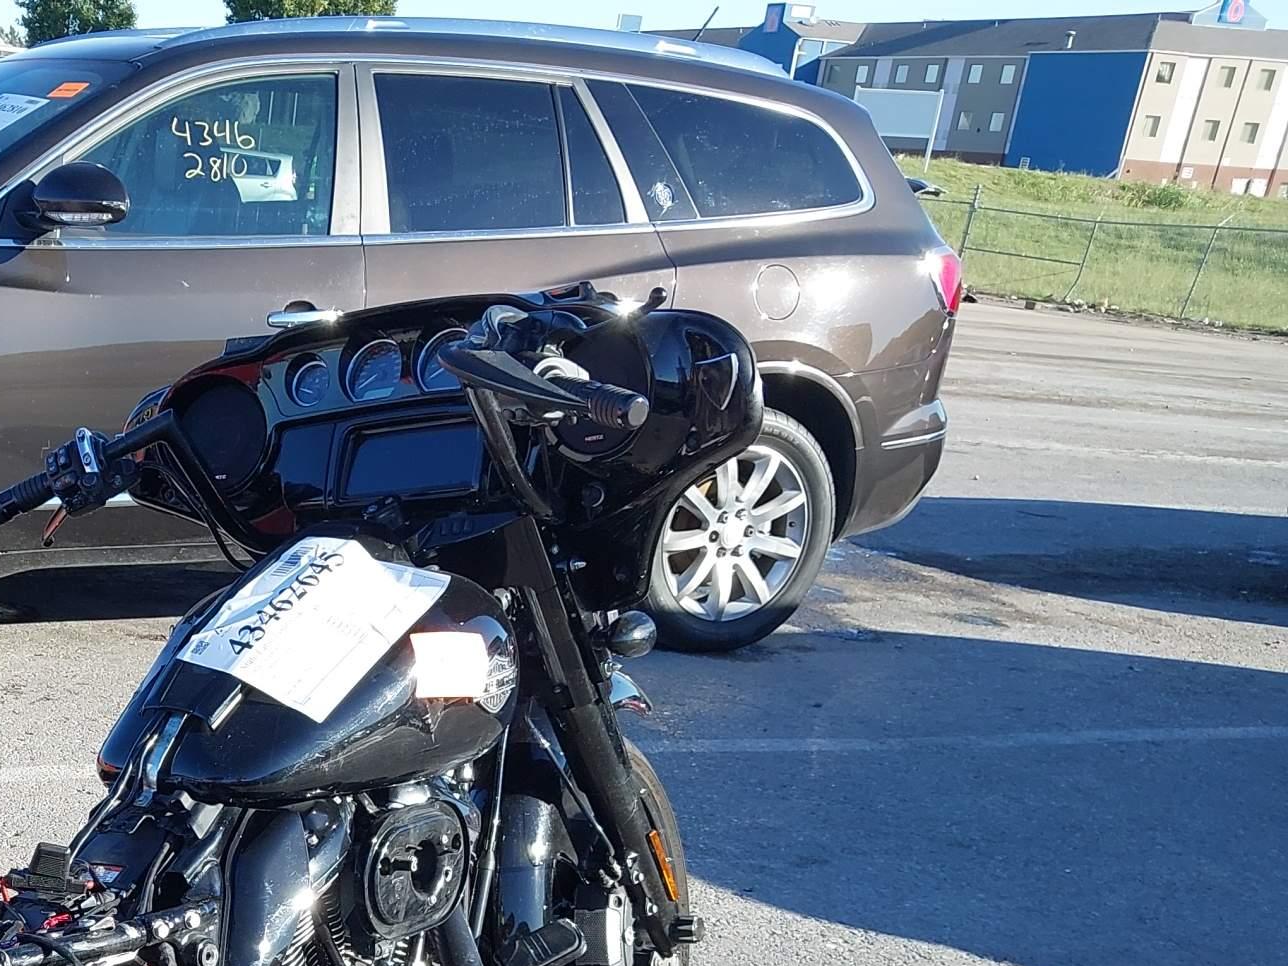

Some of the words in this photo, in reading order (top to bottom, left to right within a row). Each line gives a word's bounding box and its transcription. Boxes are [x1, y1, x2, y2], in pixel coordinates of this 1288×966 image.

[171, 116, 256, 149] 4346
[183, 152, 248, 182] 2810
[228, 551, 345, 656] 43462645
